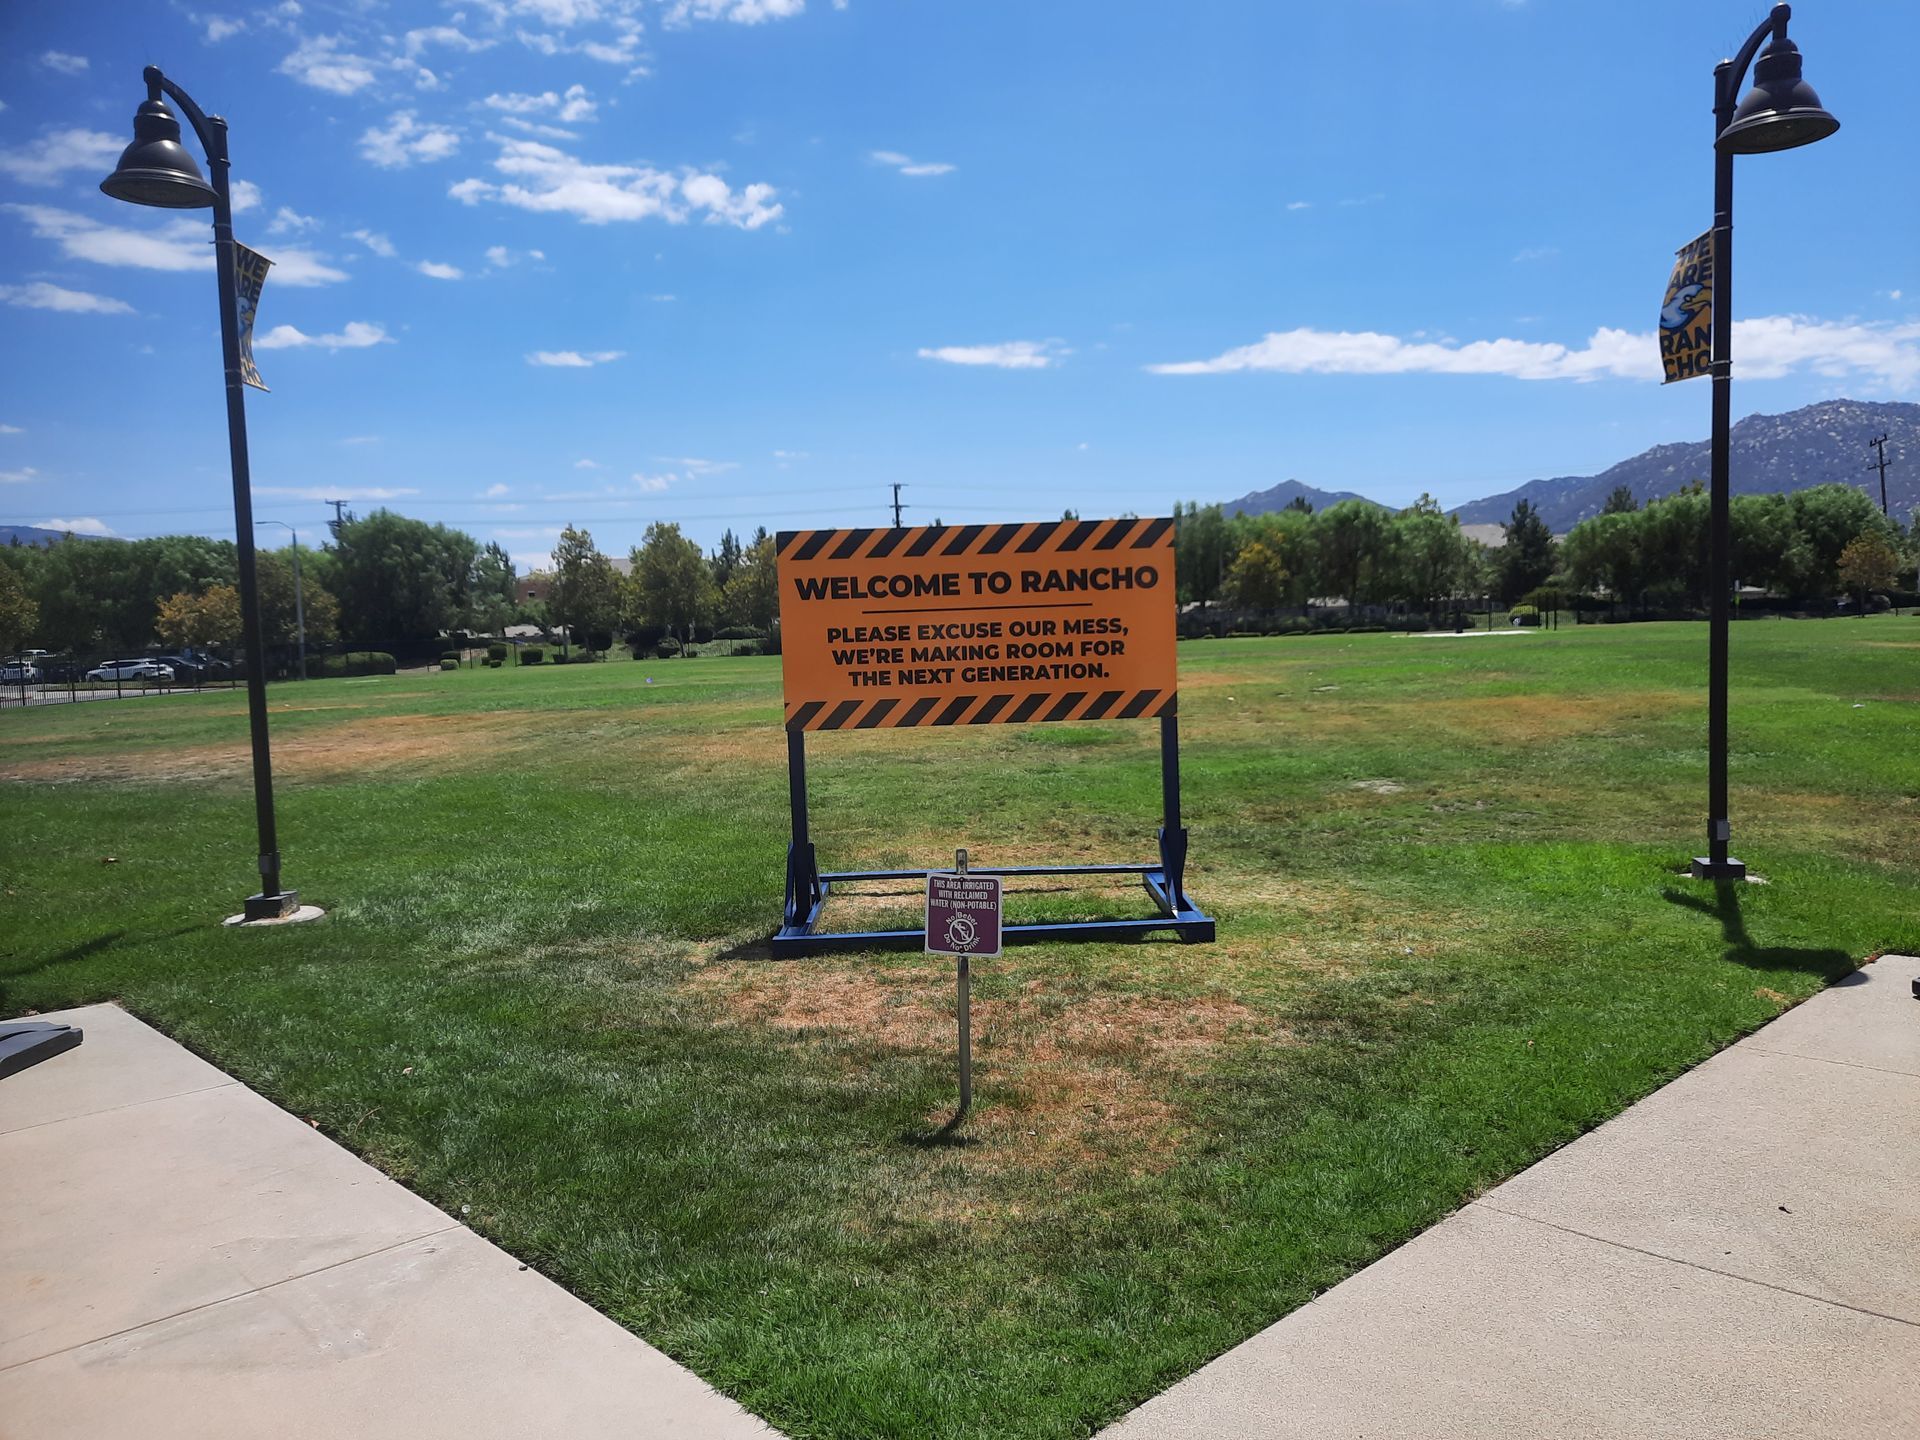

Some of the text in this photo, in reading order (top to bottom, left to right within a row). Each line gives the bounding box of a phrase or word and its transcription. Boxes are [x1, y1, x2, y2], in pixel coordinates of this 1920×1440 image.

[1670, 258, 1712, 288] ARE
[1660, 324, 1711, 356] RAN
[1663, 350, 1711, 382] CHO
[795, 565, 1159, 601] WELCOME TO RANCHO
[827, 617, 1129, 643] PLEASE EXCUSE OUR MESS,
[832, 639, 1125, 665] WE'RE MAKING ROOM FOR
[848, 663, 1110, 687] THE NEXT GENERATION.
[933, 880, 994, 890] THIS AREA IRRIGATED
[939, 890, 988, 900] WITH RECLAIMED
[930, 899, 997, 911] WATER (NON-POTABLE)
[958, 912, 978, 925] Beber
[964, 937, 980, 951] Drink
